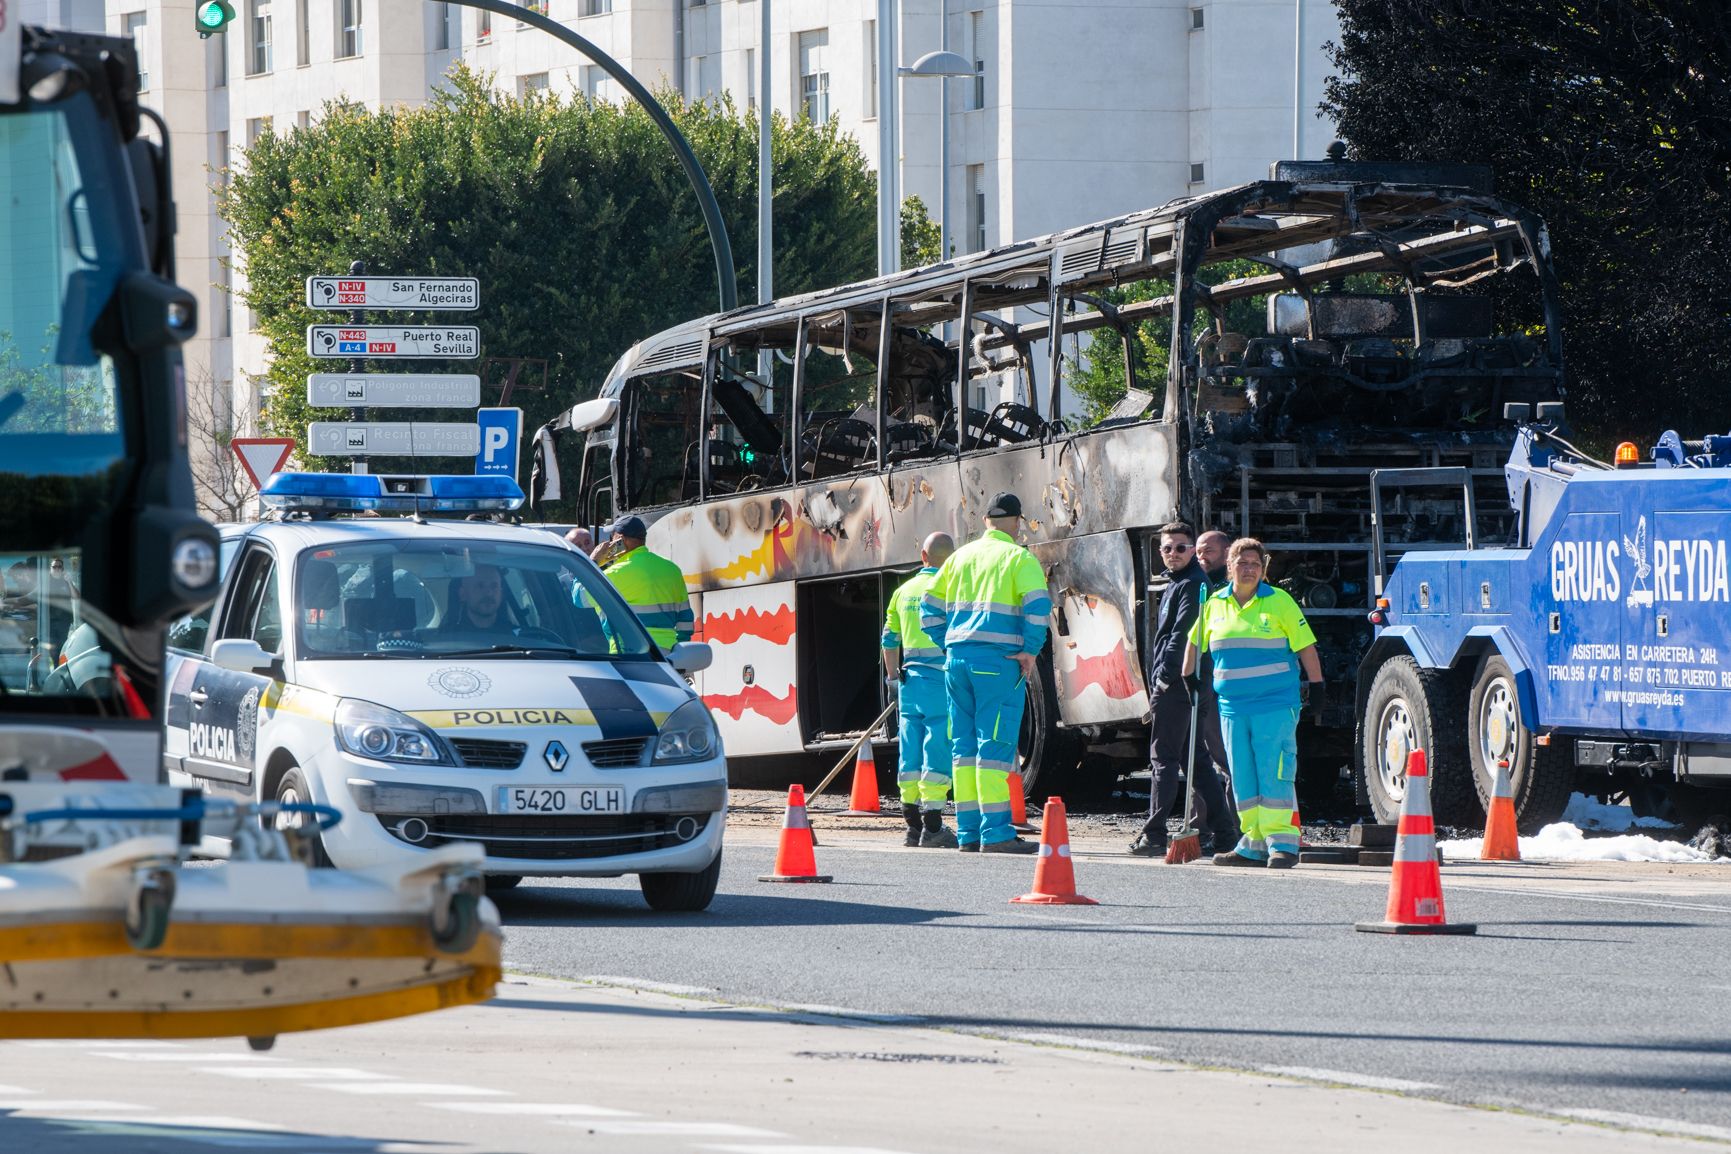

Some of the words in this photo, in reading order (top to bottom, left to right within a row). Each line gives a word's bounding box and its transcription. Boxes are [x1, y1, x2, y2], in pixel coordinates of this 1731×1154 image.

[341, 283, 362, 291] N-IV
[392, 282, 414, 292] San
[419, 282, 473, 293] Fernando
[339, 294, 365, 303] N-340
[419, 293, 473, 304] Algeciras
[339, 331, 366, 340] N-443
[403, 332, 441, 341] Puerto
[447, 332, 473, 341] Real
[345, 344, 361, 352] A-4
[371, 344, 393, 352] N-IV
[434, 344, 473, 353] Sevilla
[421, 381, 473, 391] Industrial
[406, 394, 431, 402] zona
[439, 393, 473, 402] franca
[374, 429, 426, 439] Recinto
[433, 429, 473, 440] Fiscal
[439, 442, 473, 451] franca
[484, 427, 509, 462] P
[1551, 540, 1621, 602] GRUAS
[1654, 540, 1730, 603] REYDA
[1572, 644, 1621, 660] ASISTENCIA
[1626, 645, 1638, 661] EN
[1642, 645, 1695, 663] CARRETERA
[1700, 648, 1718, 664] 24H.
[1588, 666, 1597, 682] 47
[1600, 666, 1610, 682] 47
[1613, 666, 1621, 682] 81
[1629, 667, 1643, 683] 657
[1647, 668, 1661, 684] 875
[1664, 668, 1679, 685] 702
[1682, 668, 1716, 687] PUERTO
[1605, 690, 1684, 709] www.gruasreyda.es
[453, 711, 573, 725] POLICIA
[190, 722, 236, 762] POLICIA
[515, 790, 565, 811] 5420
[581, 790, 619, 811] GLH
